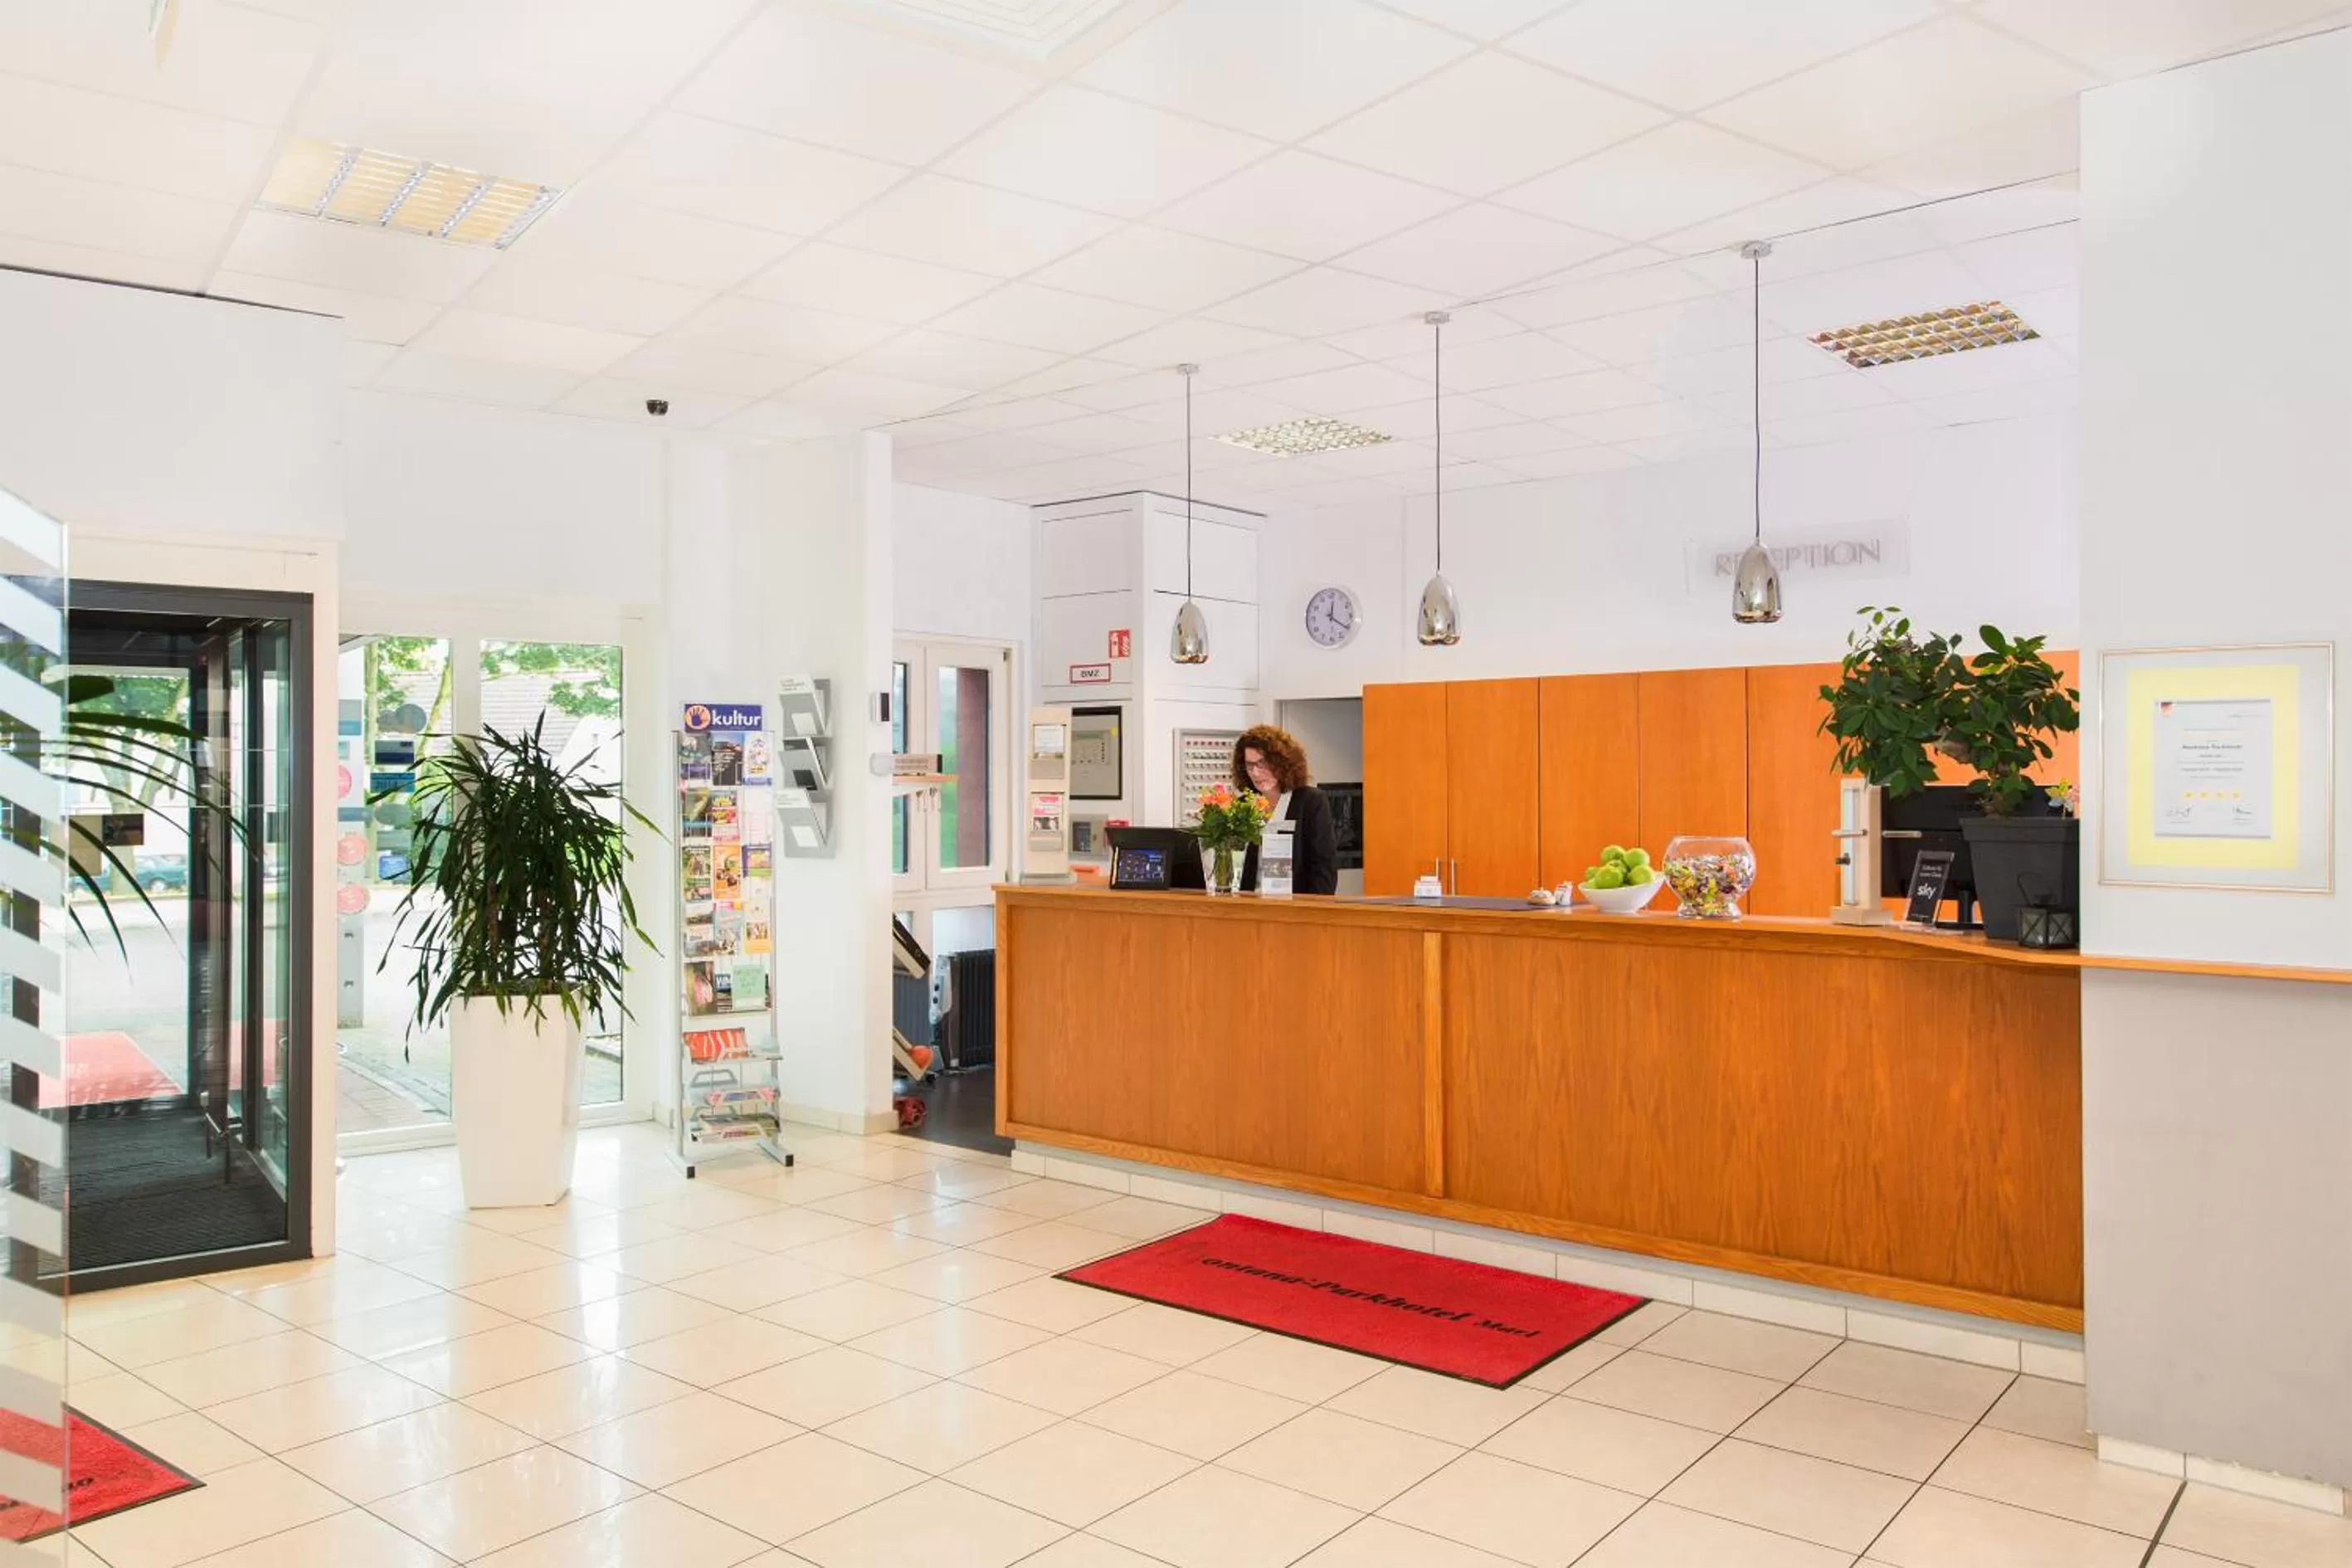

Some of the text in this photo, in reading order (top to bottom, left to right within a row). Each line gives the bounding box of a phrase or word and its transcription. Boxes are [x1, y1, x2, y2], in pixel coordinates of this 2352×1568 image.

[1715, 538, 1881, 577] REEPTION
[712, 709, 761, 726] kultur
[1916, 882, 1936, 900] sky
